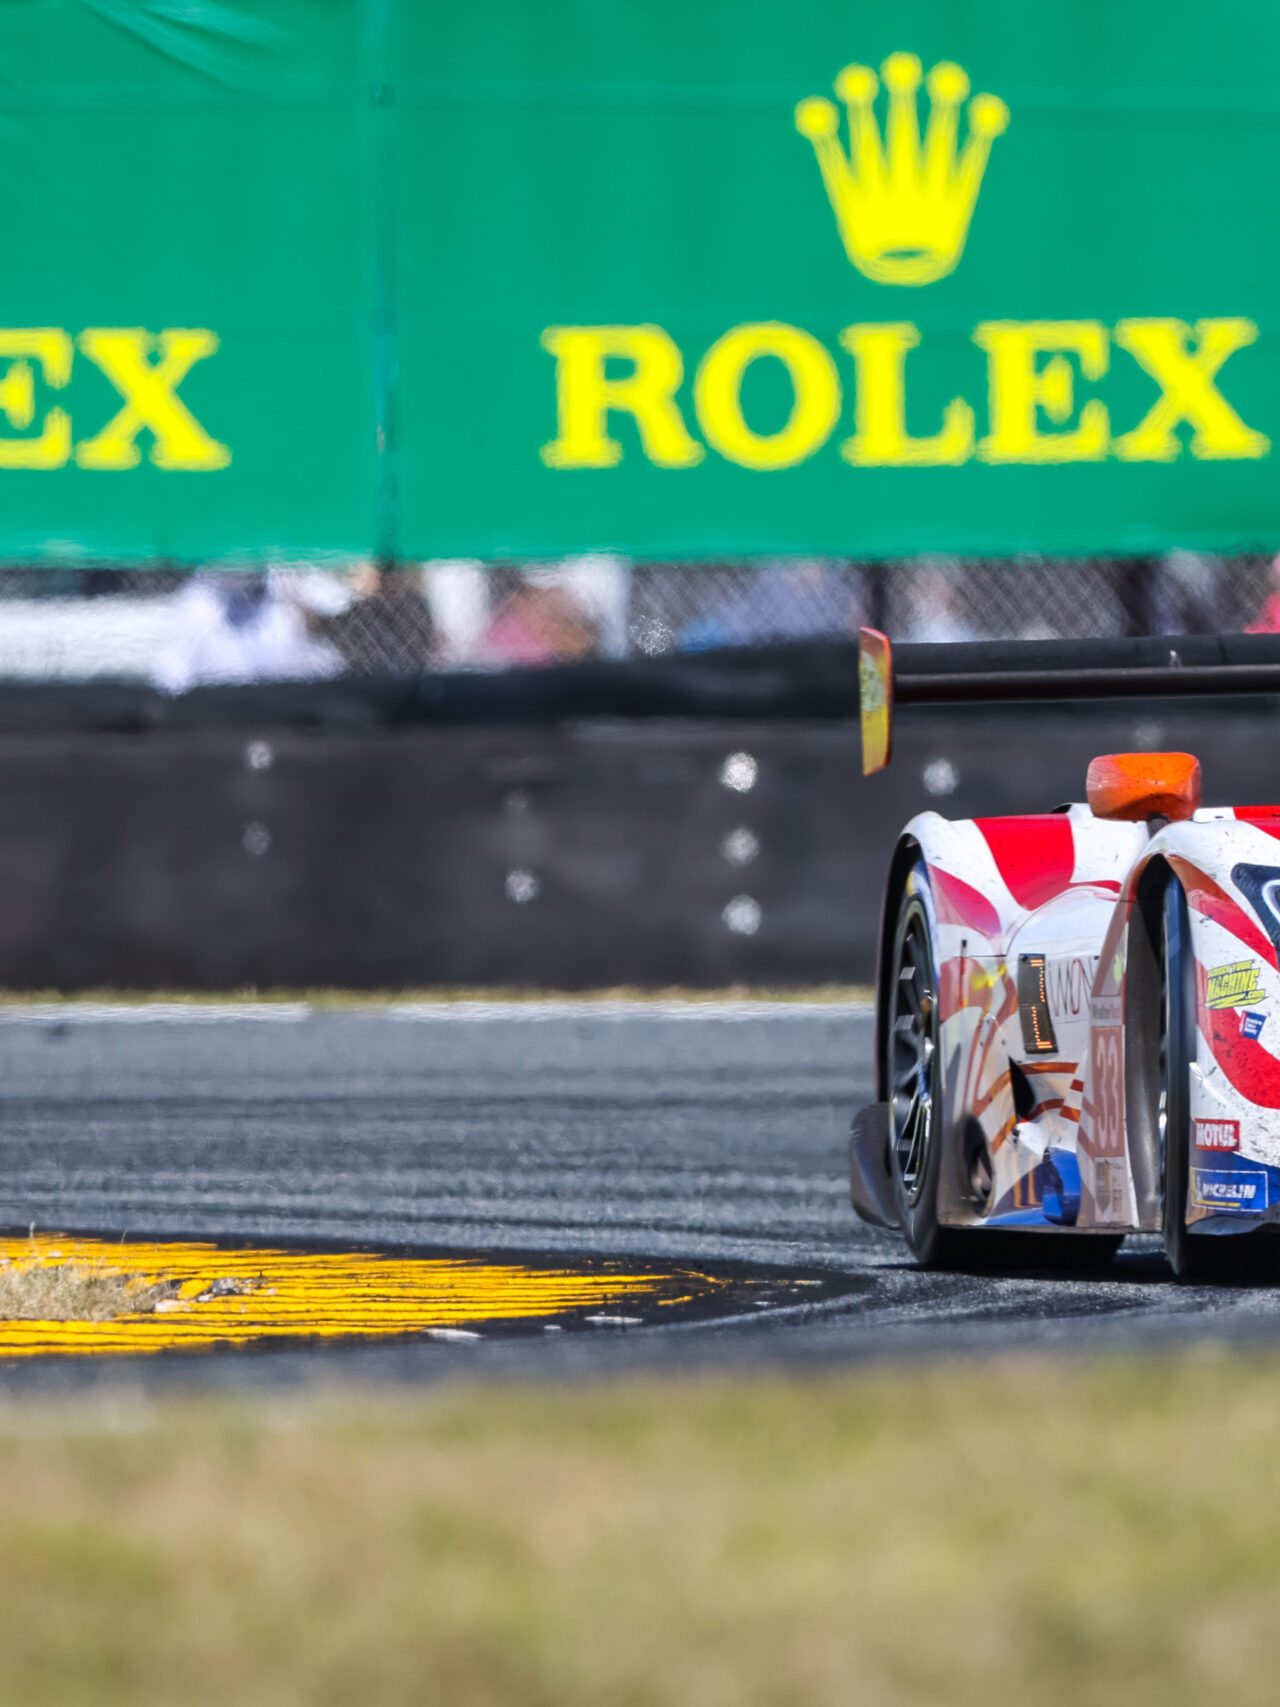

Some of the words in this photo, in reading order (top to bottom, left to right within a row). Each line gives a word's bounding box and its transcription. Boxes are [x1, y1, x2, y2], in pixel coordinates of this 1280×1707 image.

[542, 321, 1268, 470] ROLEX
[1207, 968, 1261, 1002] MACHINE
[1096, 1035, 1119, 1149] 33
[1196, 1123, 1237, 1147] MOTUL
[1202, 1183, 1257, 1199] MICHELIN
